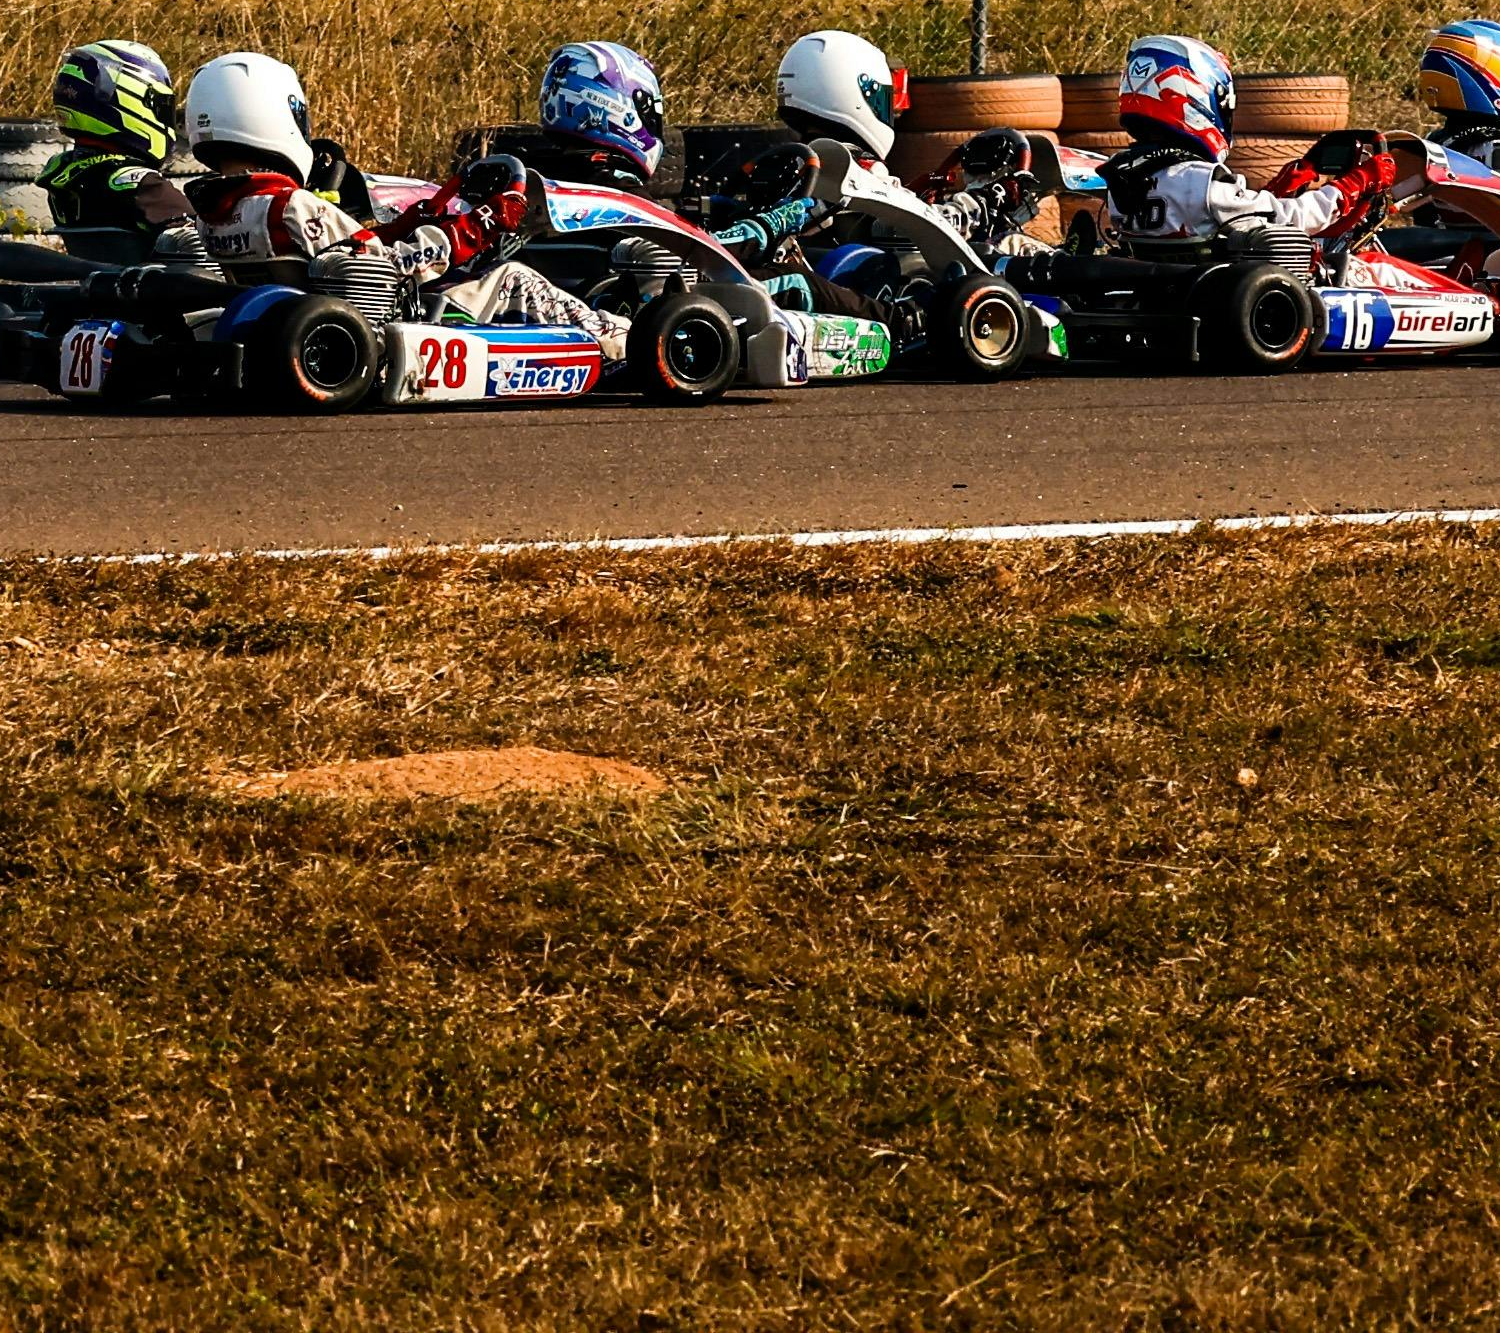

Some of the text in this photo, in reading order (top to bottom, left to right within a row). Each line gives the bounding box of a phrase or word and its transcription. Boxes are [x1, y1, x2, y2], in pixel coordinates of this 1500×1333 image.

[1397, 310, 1492, 332] birelart
[68, 333, 97, 389] 28
[417, 338, 468, 389] 28
[508, 366, 590, 393] Energy
